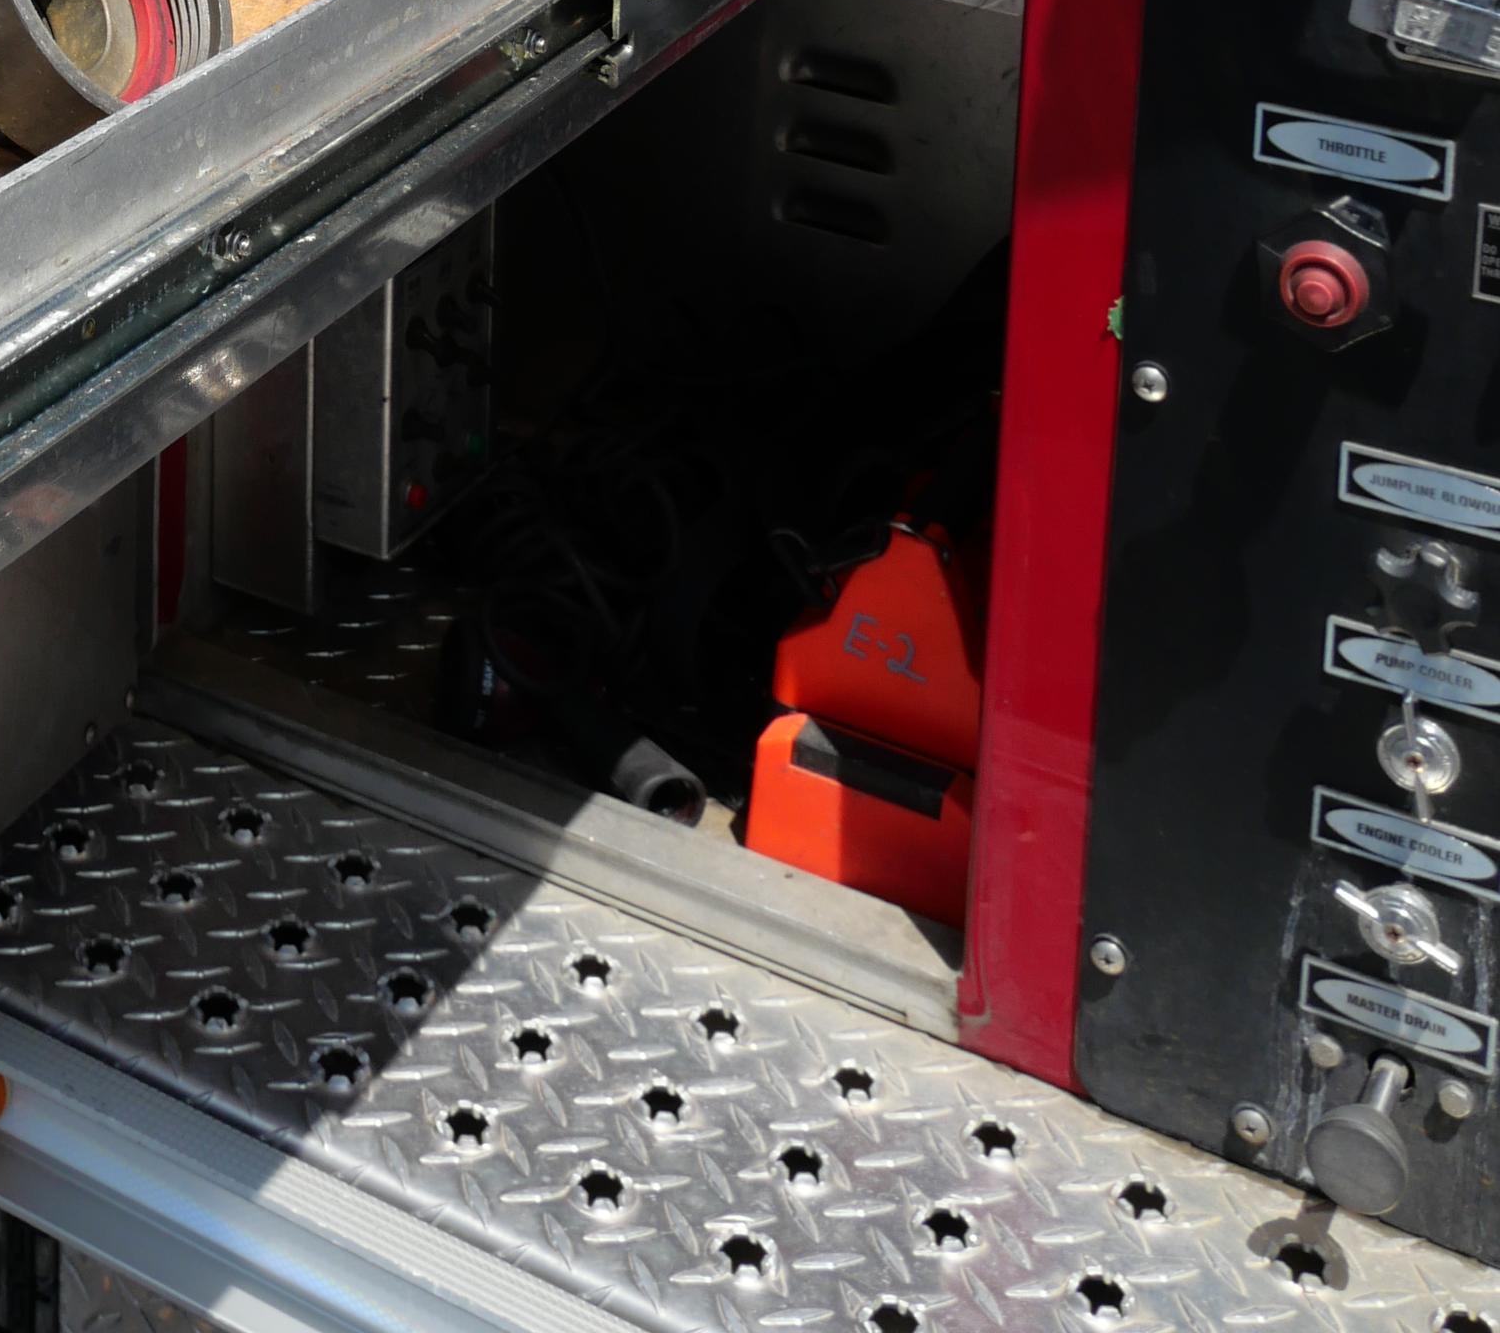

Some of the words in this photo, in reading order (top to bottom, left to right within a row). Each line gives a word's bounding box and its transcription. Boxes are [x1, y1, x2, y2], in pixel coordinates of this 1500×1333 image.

[1317, 138, 1388, 164] THROTTLE
[1369, 473, 1437, 501] JUMPLINE
[843, 612, 927, 684] E-2
[1375, 652, 1415, 671] PUMP
[1418, 664, 1473, 690] COOLER
[1356, 822, 1406, 848] ENGINE
[1408, 839, 1464, 866] COOLER
[1346, 992, 1401, 1022] MASTER
[1404, 1013, 1448, 1037] DRAIN
